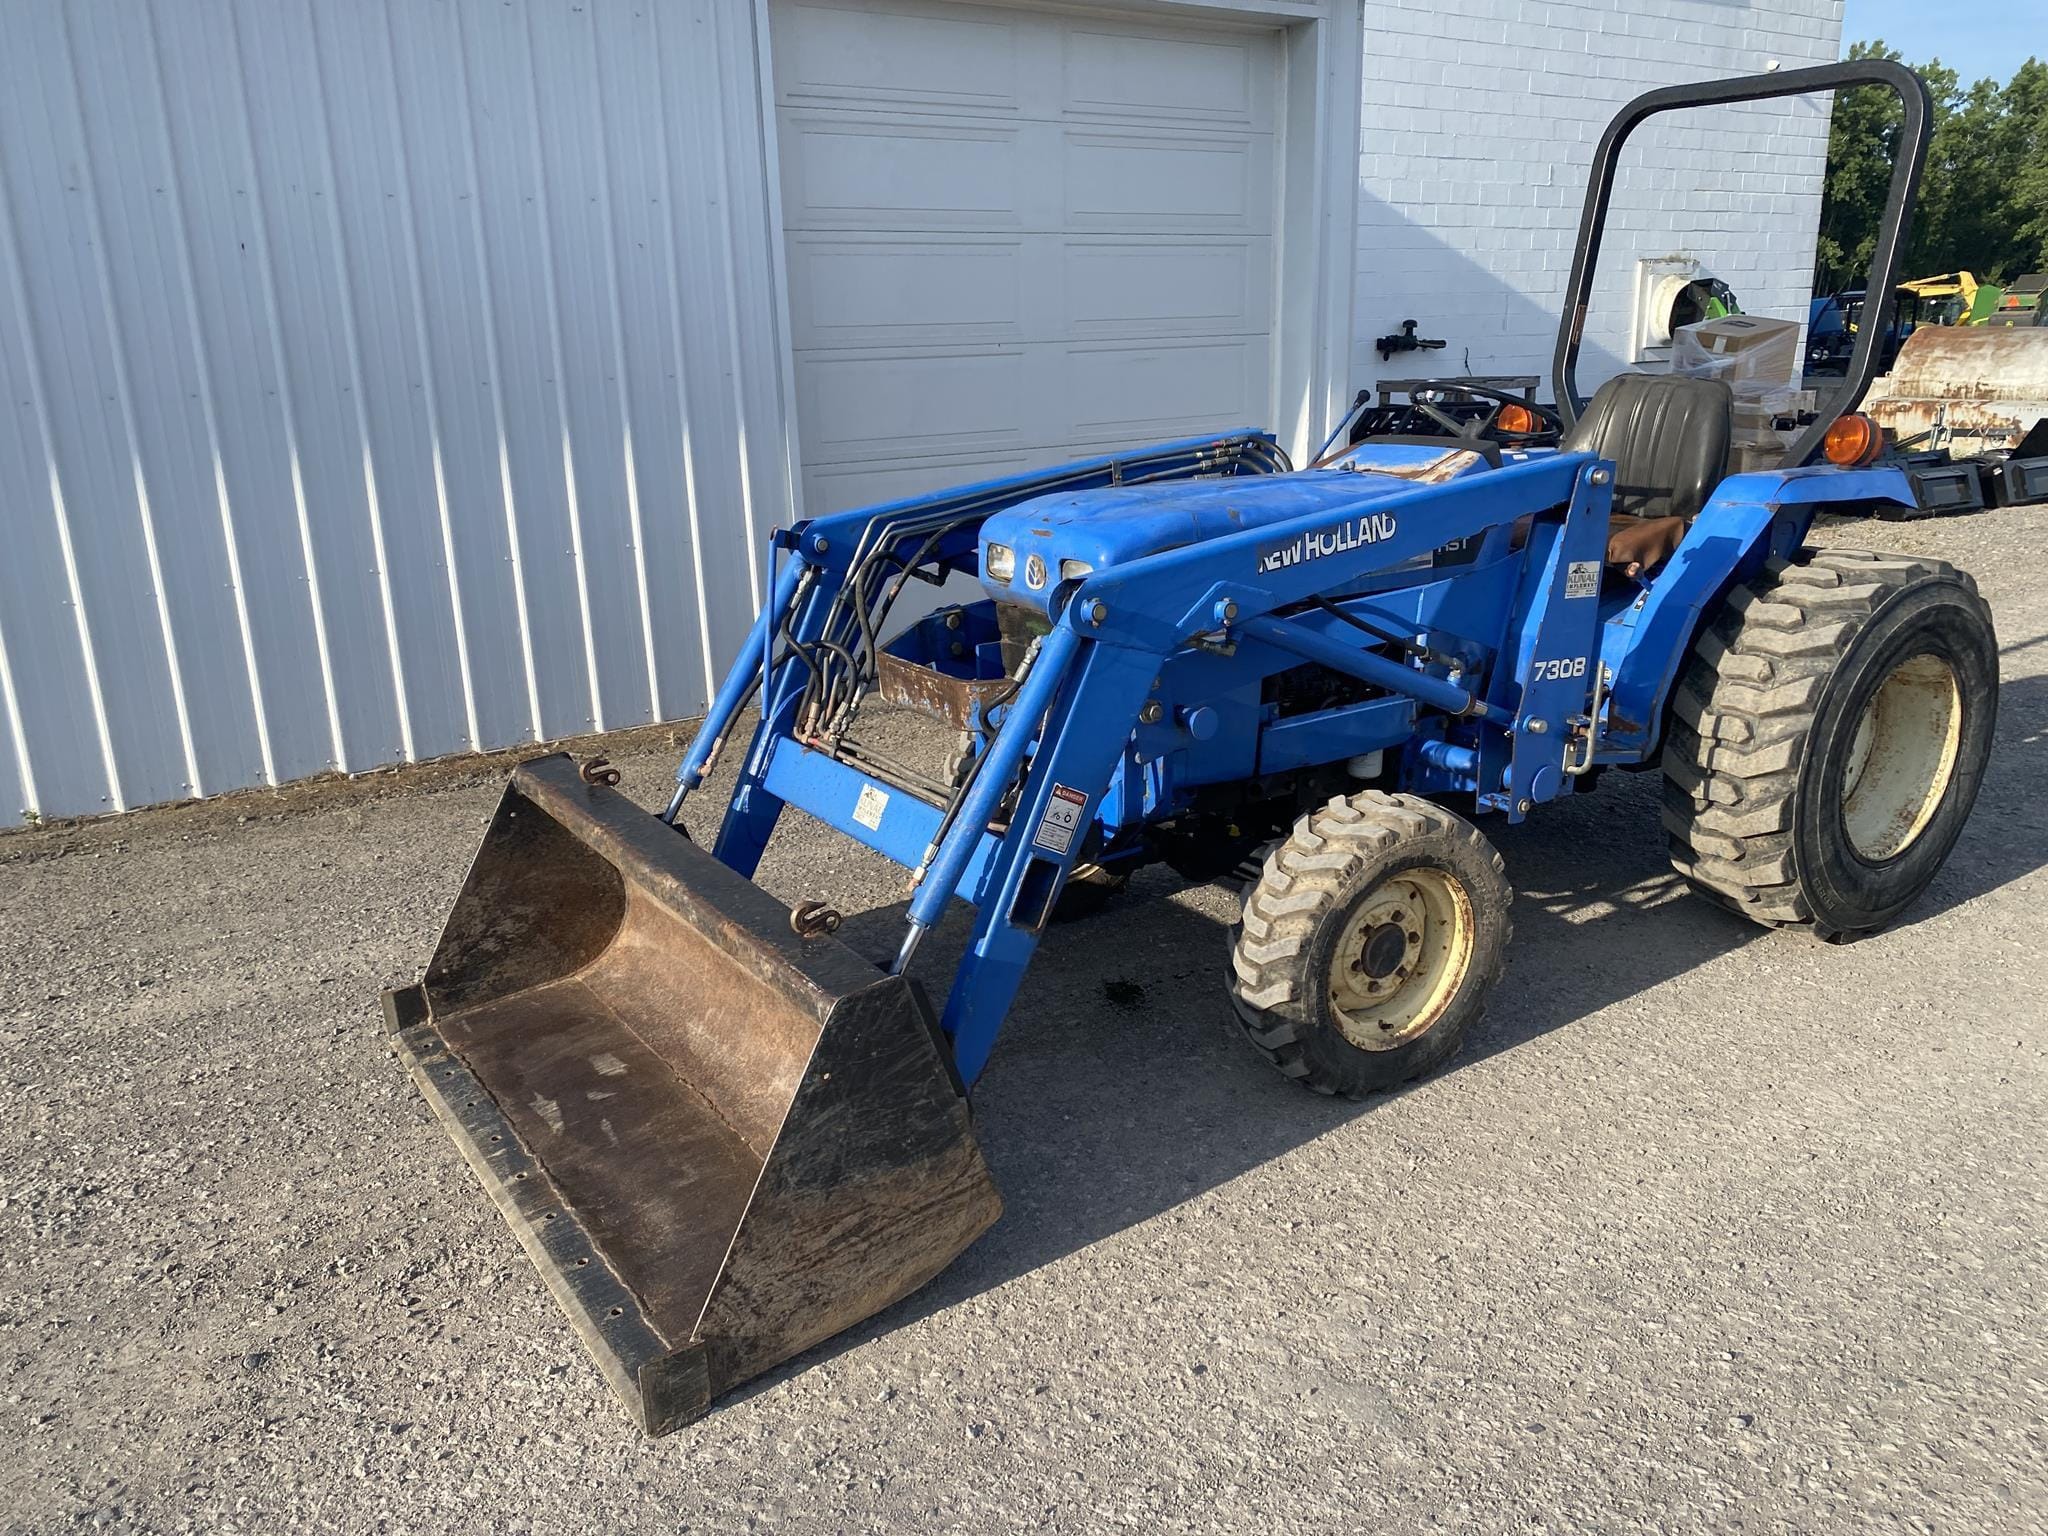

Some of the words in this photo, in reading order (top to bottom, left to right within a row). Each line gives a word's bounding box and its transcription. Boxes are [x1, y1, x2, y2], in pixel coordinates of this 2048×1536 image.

[1258, 540, 1302, 574] NEW
[1304, 512, 1397, 561] HOLLAND
[1534, 656, 1586, 682] 7308
[1062, 790, 1084, 803] DANGER
